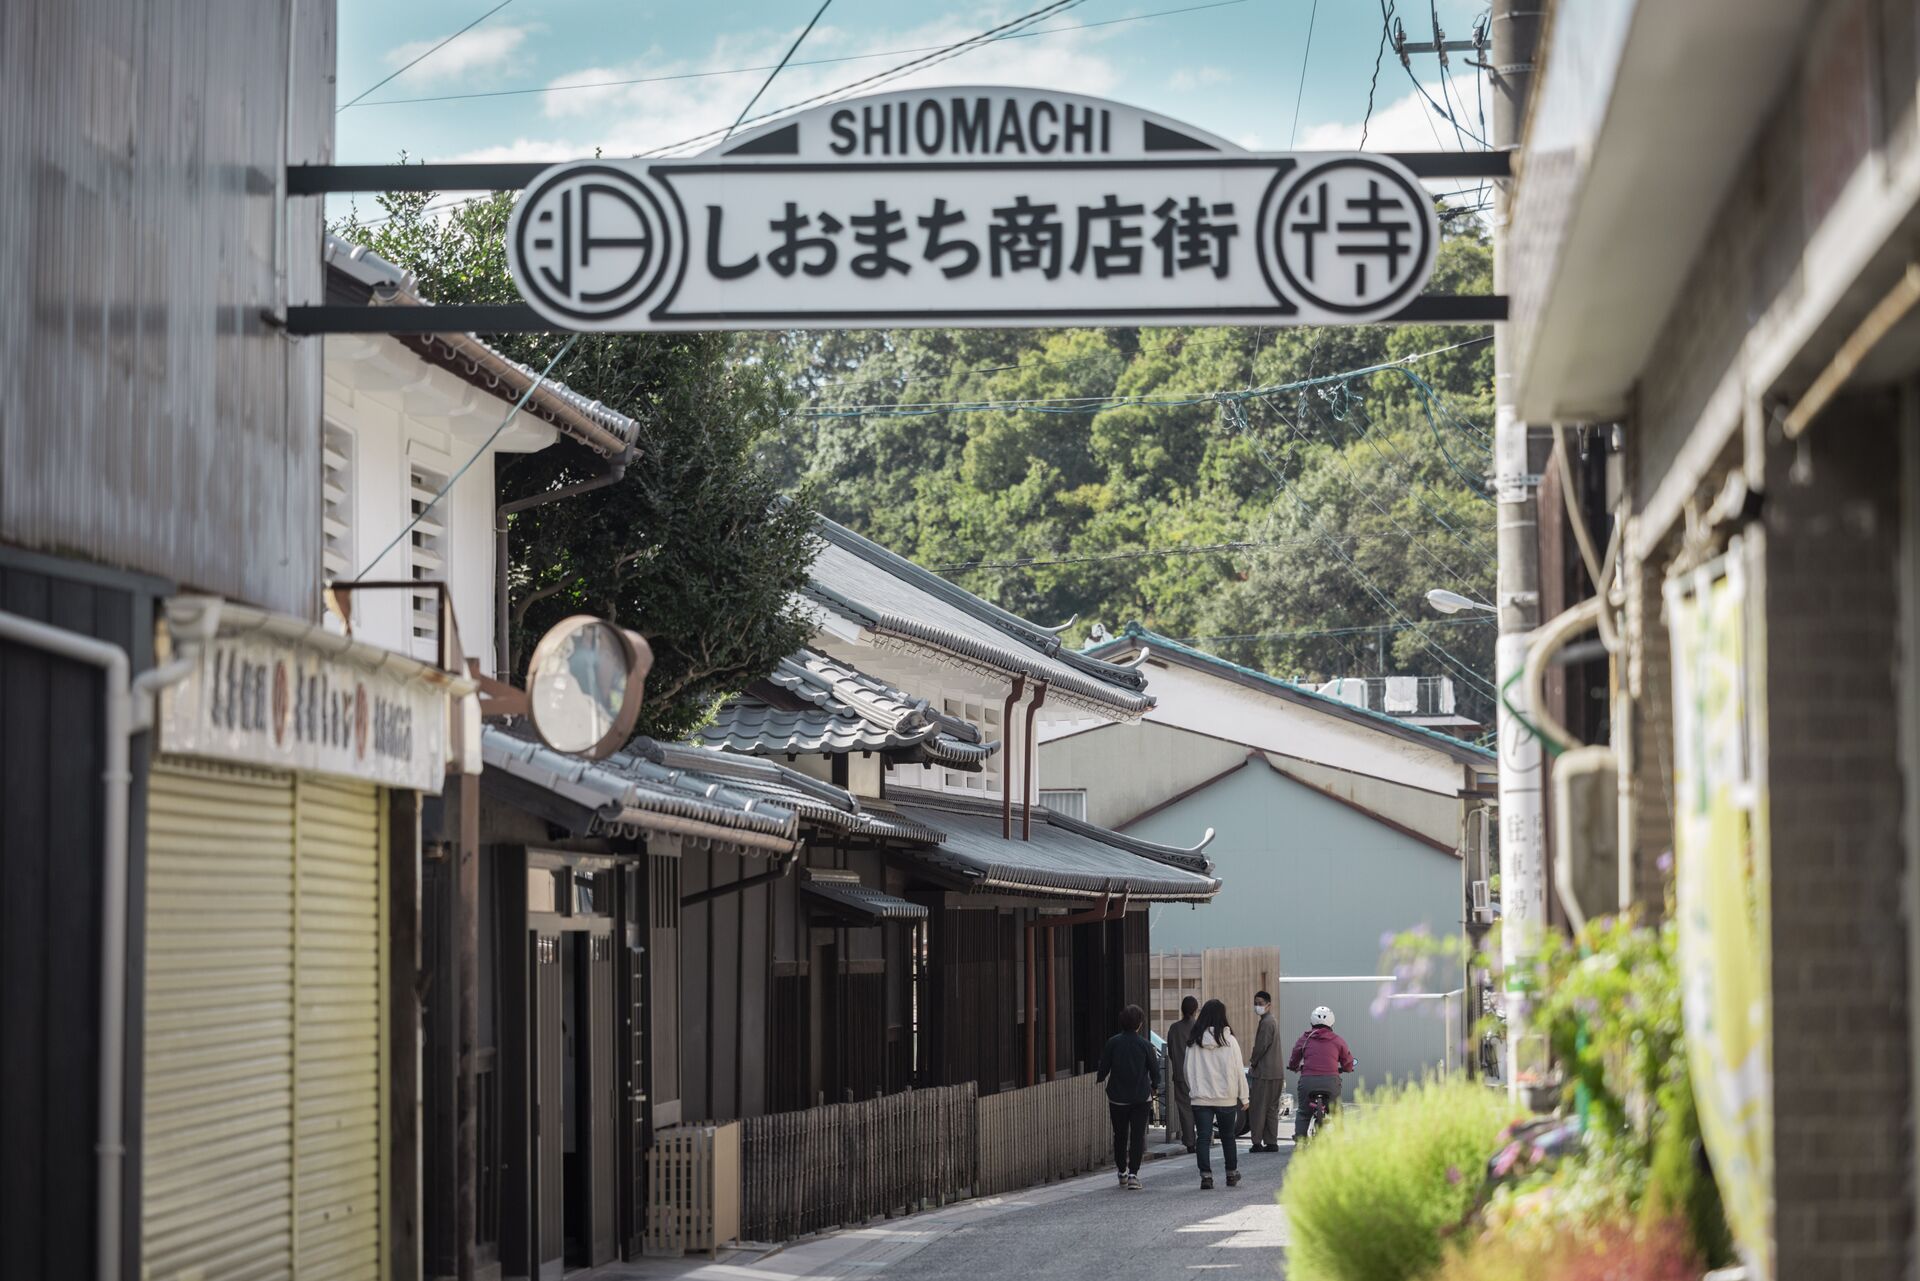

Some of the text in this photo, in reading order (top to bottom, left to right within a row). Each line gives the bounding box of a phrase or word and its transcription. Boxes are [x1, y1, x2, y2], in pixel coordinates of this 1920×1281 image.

[828, 97, 1111, 157] SHIOMACHI
[705, 194, 1239, 281] しおまち商店街
[1290, 179, 1411, 297] 待
